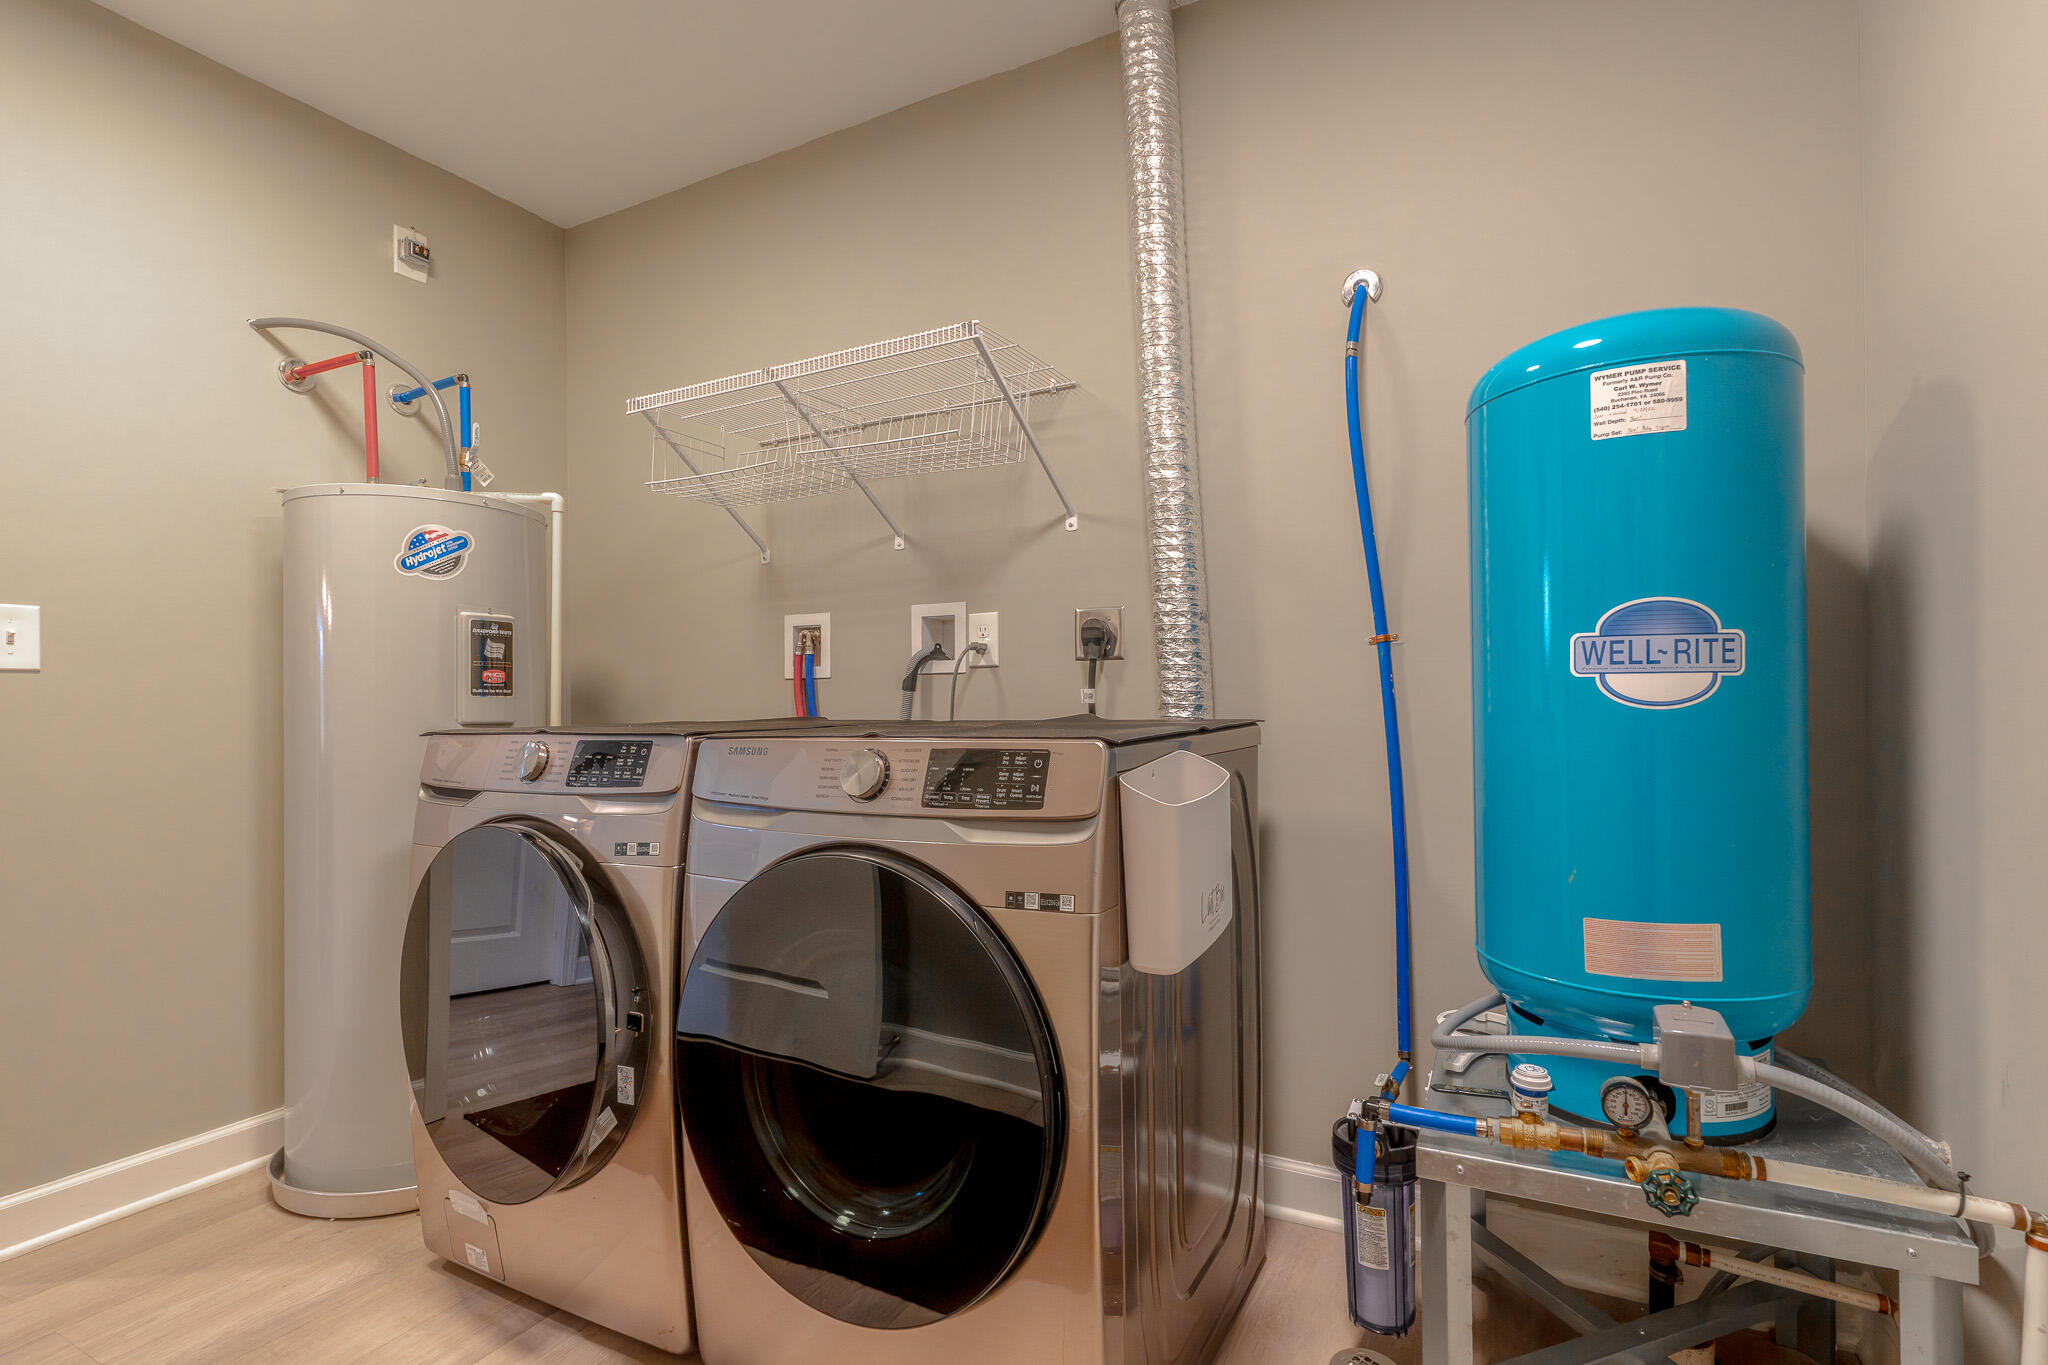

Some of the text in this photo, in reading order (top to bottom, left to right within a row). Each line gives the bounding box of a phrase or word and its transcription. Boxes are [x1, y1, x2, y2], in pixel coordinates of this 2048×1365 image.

[1594, 365, 1682, 382] WYMER PUMP SERVICE
[1603, 378, 1628, 386] Formerly
[1611, 401, 1642, 410] 254-1701
[1593, 431, 1610, 439] Pump
[405, 543, 447, 567] Hydrojet
[727, 746, 769, 756] SAMSUNG
